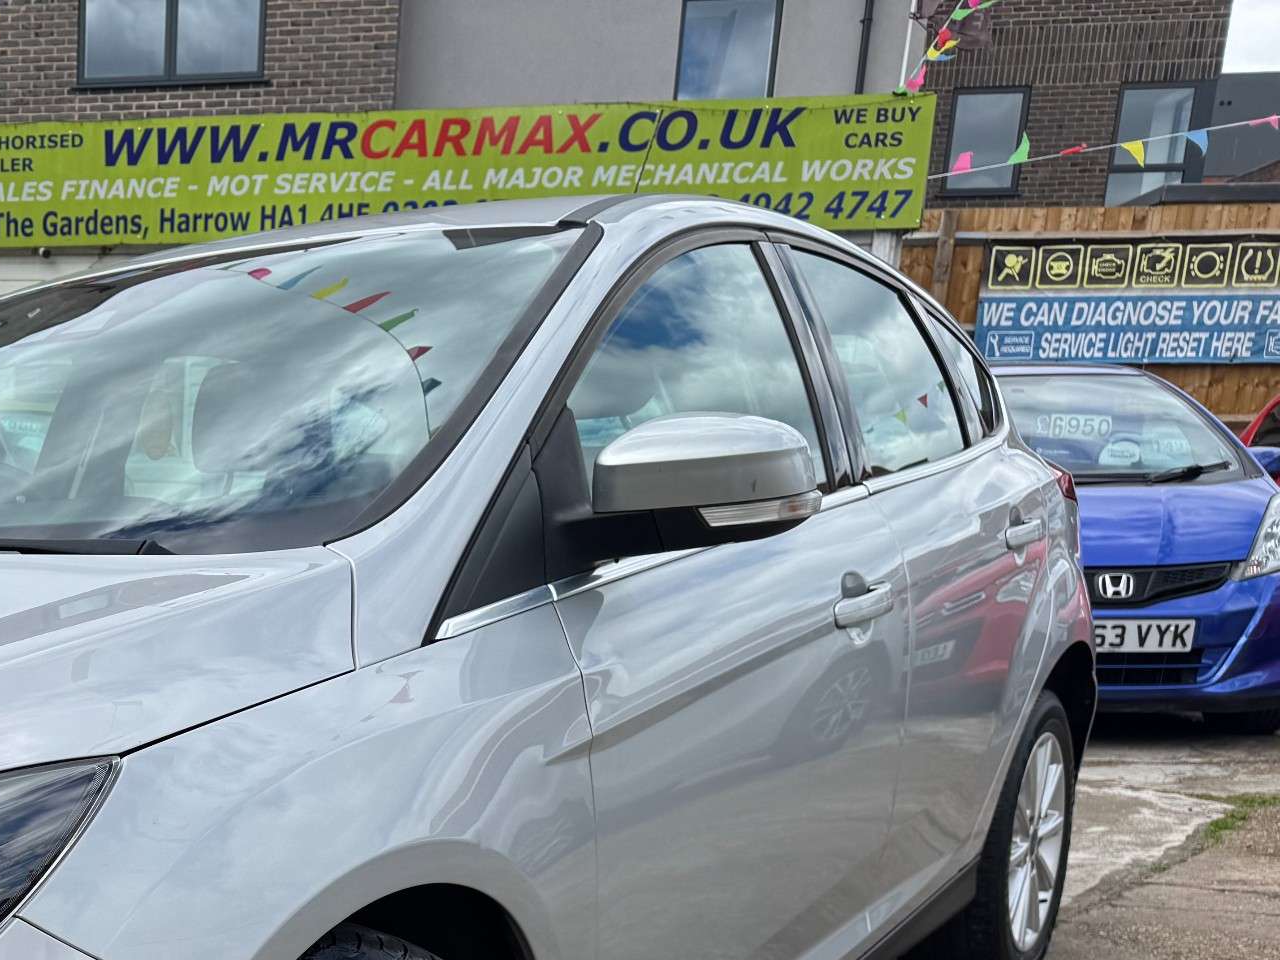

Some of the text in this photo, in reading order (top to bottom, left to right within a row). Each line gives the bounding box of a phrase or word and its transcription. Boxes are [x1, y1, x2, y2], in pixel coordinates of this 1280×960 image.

[832, 105, 923, 125] WE BUY
[103, 106, 806, 167] WWW.MRCARMAX.CO.UK
[843, 131, 904, 149] CARS
[61, 176, 180, 201] FINANCE
[206, 174, 268, 198] MOT
[273, 170, 396, 194] SERVICE
[422, 168, 473, 192] ALL
[483, 165, 582, 190] MAJOR
[591, 160, 788, 189] MECHANICAL
[801, 157, 917, 182] WORKS
[42, 208, 149, 240] Gardens,
[159, 203, 250, 235] Harrow
[260, 203, 307, 230] HA1
[824, 188, 914, 220] 4747
[1139, 275, 1171, 284] CHECK
[982, 302, 1016, 327] WE
[1020, 301, 1068, 327] CAN
[1070, 301, 1186, 327] DIAGNOSE
[1191, 301, 1253, 326] YOUR
[1038, 332, 1105, 359] SERVICE
[1107, 332, 1156, 358] LIGHT
[1156, 332, 1211, 358] RESET
[1210, 331, 1256, 358] HERE
[1137, 624, 1191, 648] VYK
